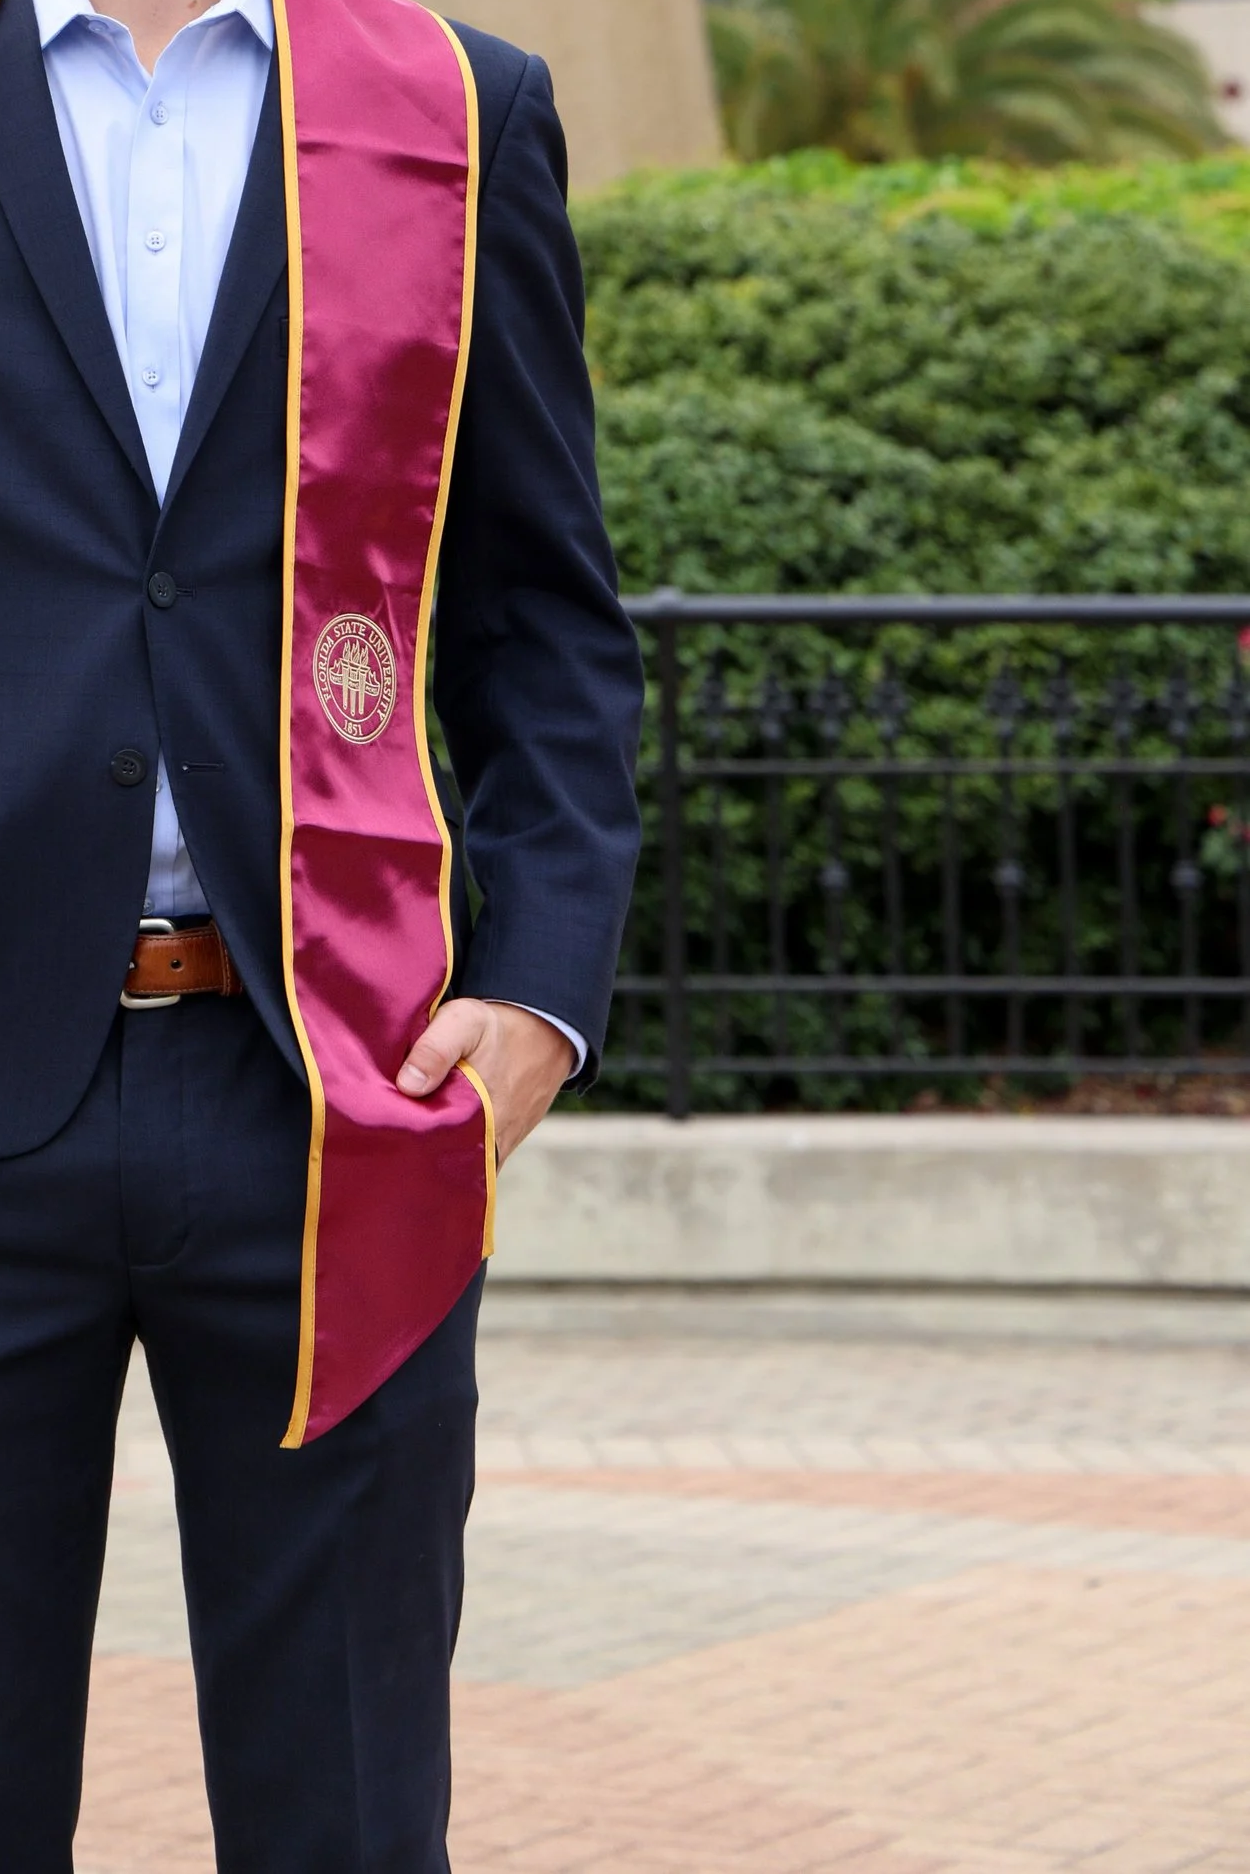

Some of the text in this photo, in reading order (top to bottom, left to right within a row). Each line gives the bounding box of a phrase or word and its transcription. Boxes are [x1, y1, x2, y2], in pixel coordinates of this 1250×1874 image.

[318, 621, 392, 721] FLORIDA STATE UNIVERSITY
[344, 719, 363, 736] 1851
